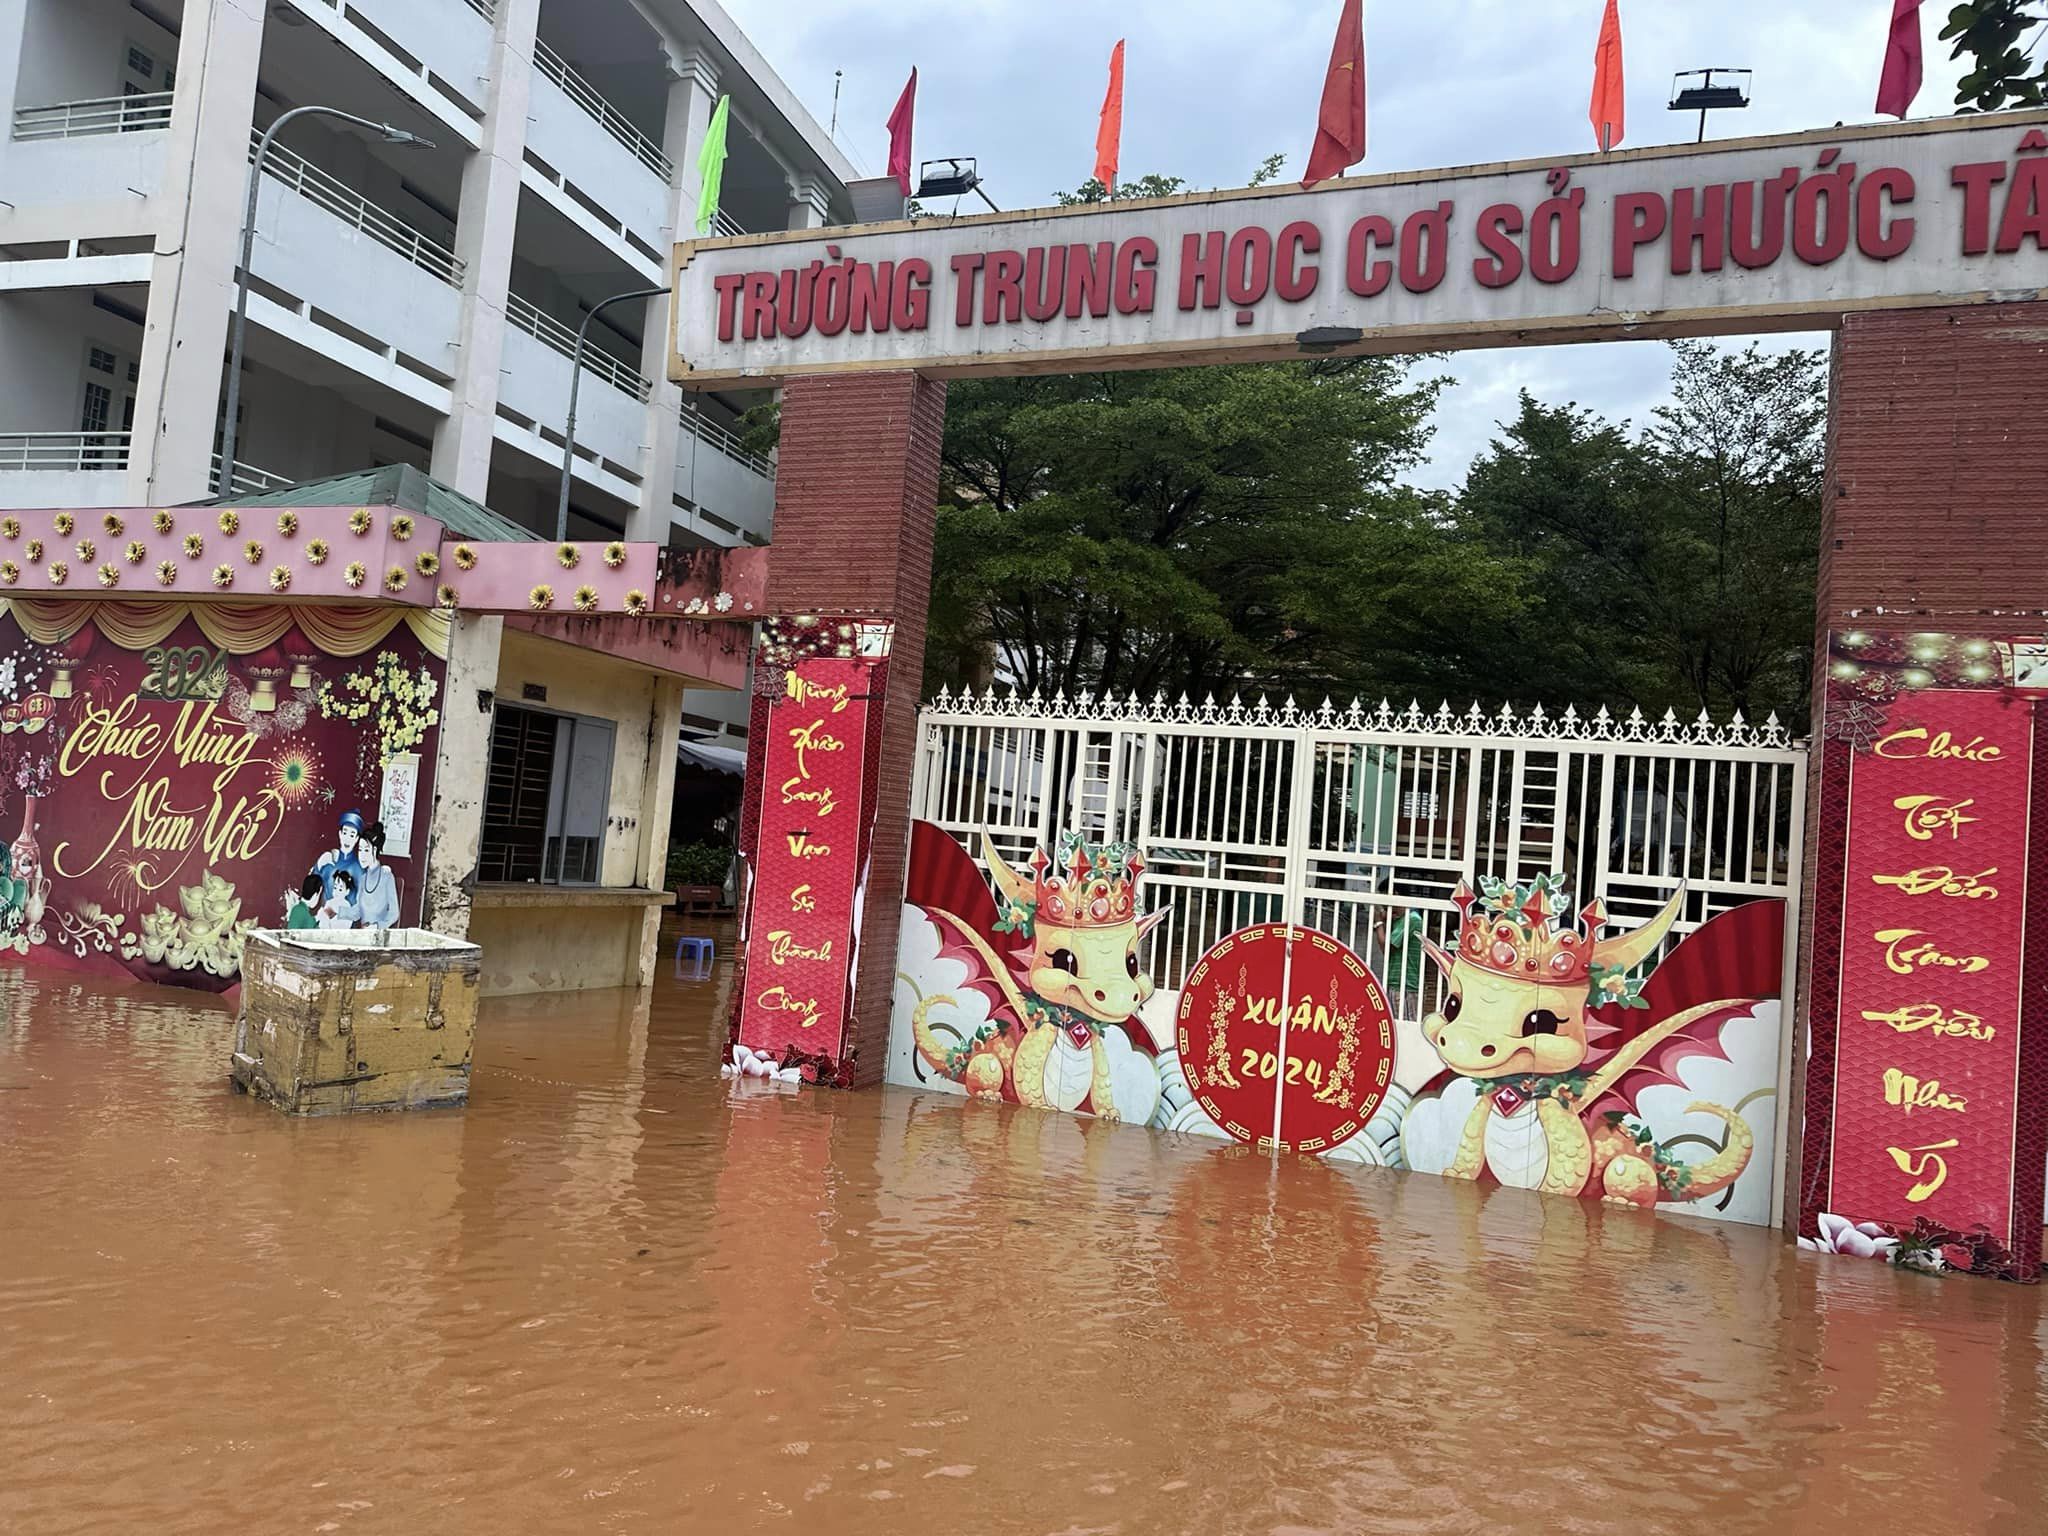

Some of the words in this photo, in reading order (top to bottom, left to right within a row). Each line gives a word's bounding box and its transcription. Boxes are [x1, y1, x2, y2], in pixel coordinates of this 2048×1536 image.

[713, 244, 932, 342] TRƯỜNG
[950, 235, 1159, 328] TRUNG
[1177, 220, 1321, 326] HỌC
[1345, 200, 1453, 297] CƠ
[1473, 165, 1586, 289] SỞ
[1606, 147, 1917, 280] PHƯỚC
[1951, 129, 2048, 257] TÂ
[141, 646, 230, 702] 2024
[59, 694, 162, 777] Chúc
[101, 700, 284, 801] Mừng
[788, 719, 845, 778] Xuân
[1874, 727, 2008, 763] Chúc
[780, 778, 840, 818] Sang
[1892, 793, 1981, 842] Tết
[53, 777, 206, 878] Năm
[786, 830, 831, 860] Vạn
[790, 884, 816, 913] Sự
[1872, 864, 2000, 900] Đến
[767, 930, 833, 965] Thành
[1872, 928, 1991, 975] Trăm
[757, 986, 824, 1029] Công
[1242, 994, 1339, 1036] XUÂN
[1861, 1003, 1997, 1043] Điều
[1240, 1048, 1323, 1090] 2024
[1882, 1067, 1970, 1114] Như
[1885, 1138, 1961, 1203] Ý
